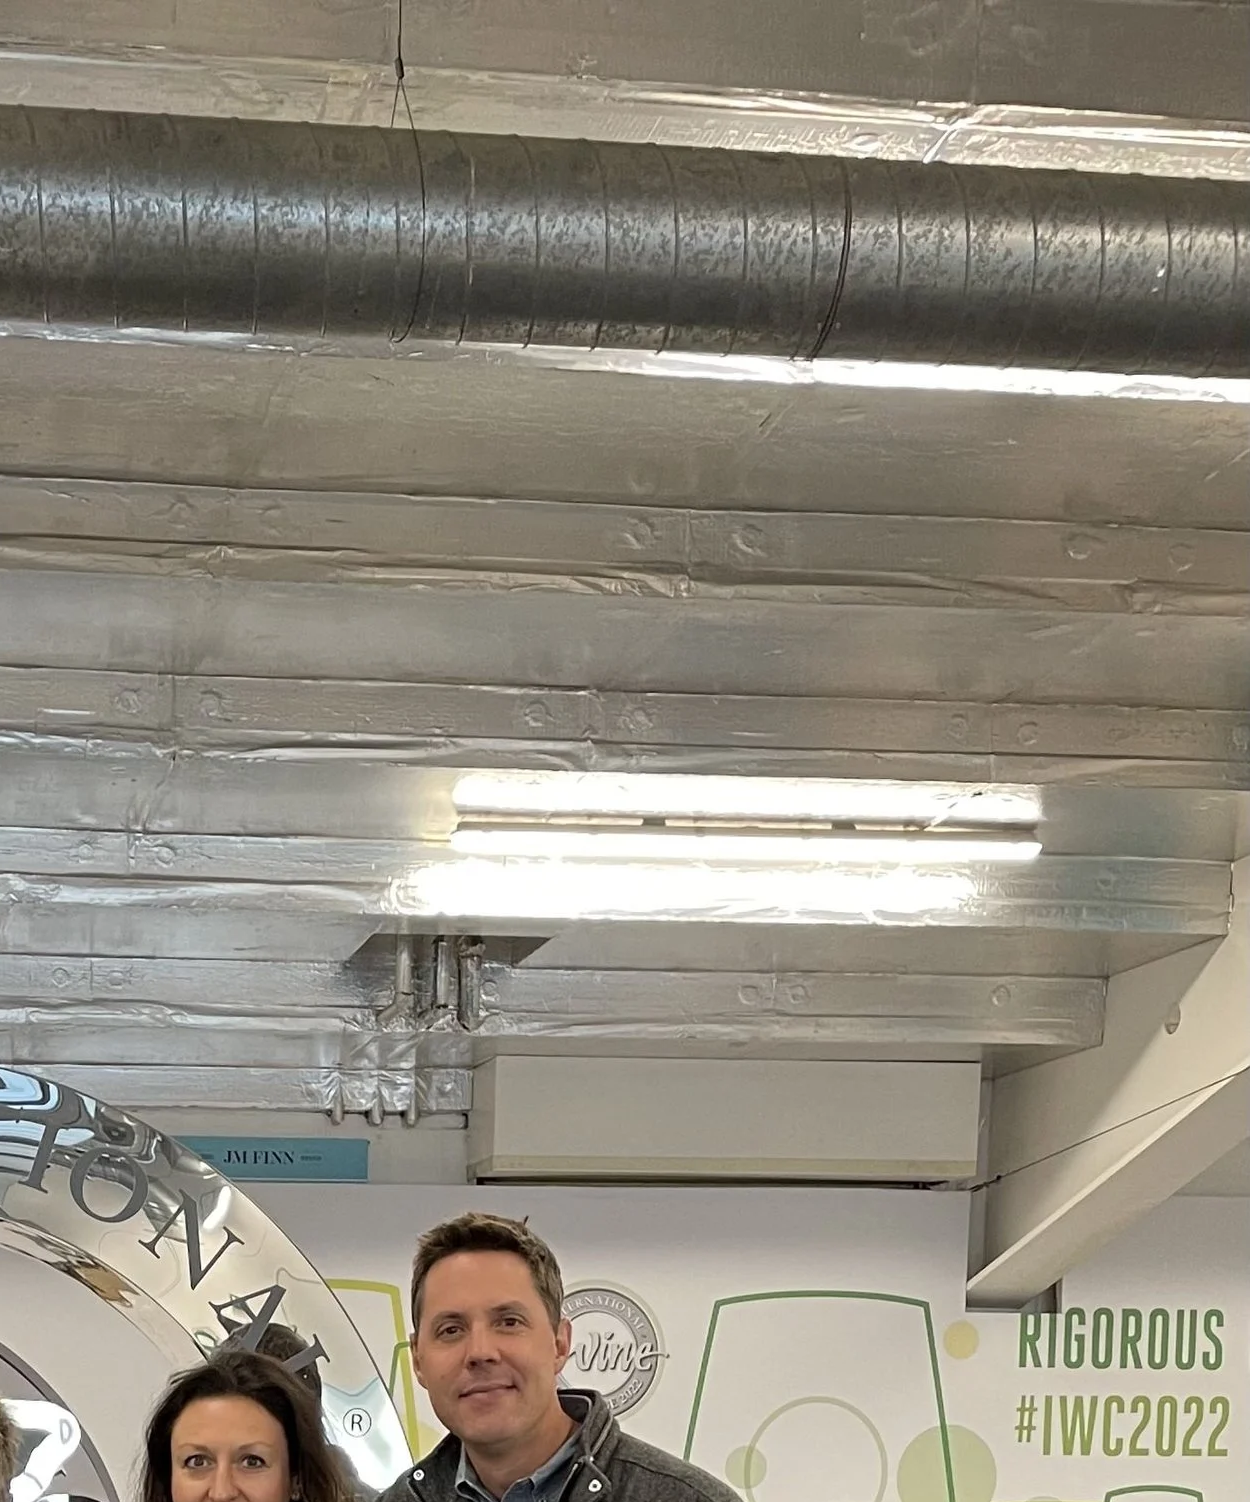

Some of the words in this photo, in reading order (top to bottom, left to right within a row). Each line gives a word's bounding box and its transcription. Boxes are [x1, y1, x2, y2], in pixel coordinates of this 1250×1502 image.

[223, 1150, 247, 1165] JM
[253, 1150, 295, 1165] FINN
[1018, 1307, 1225, 1371] RIGOROUS
[1014, 1394, 1231, 1457] #IWC2022
